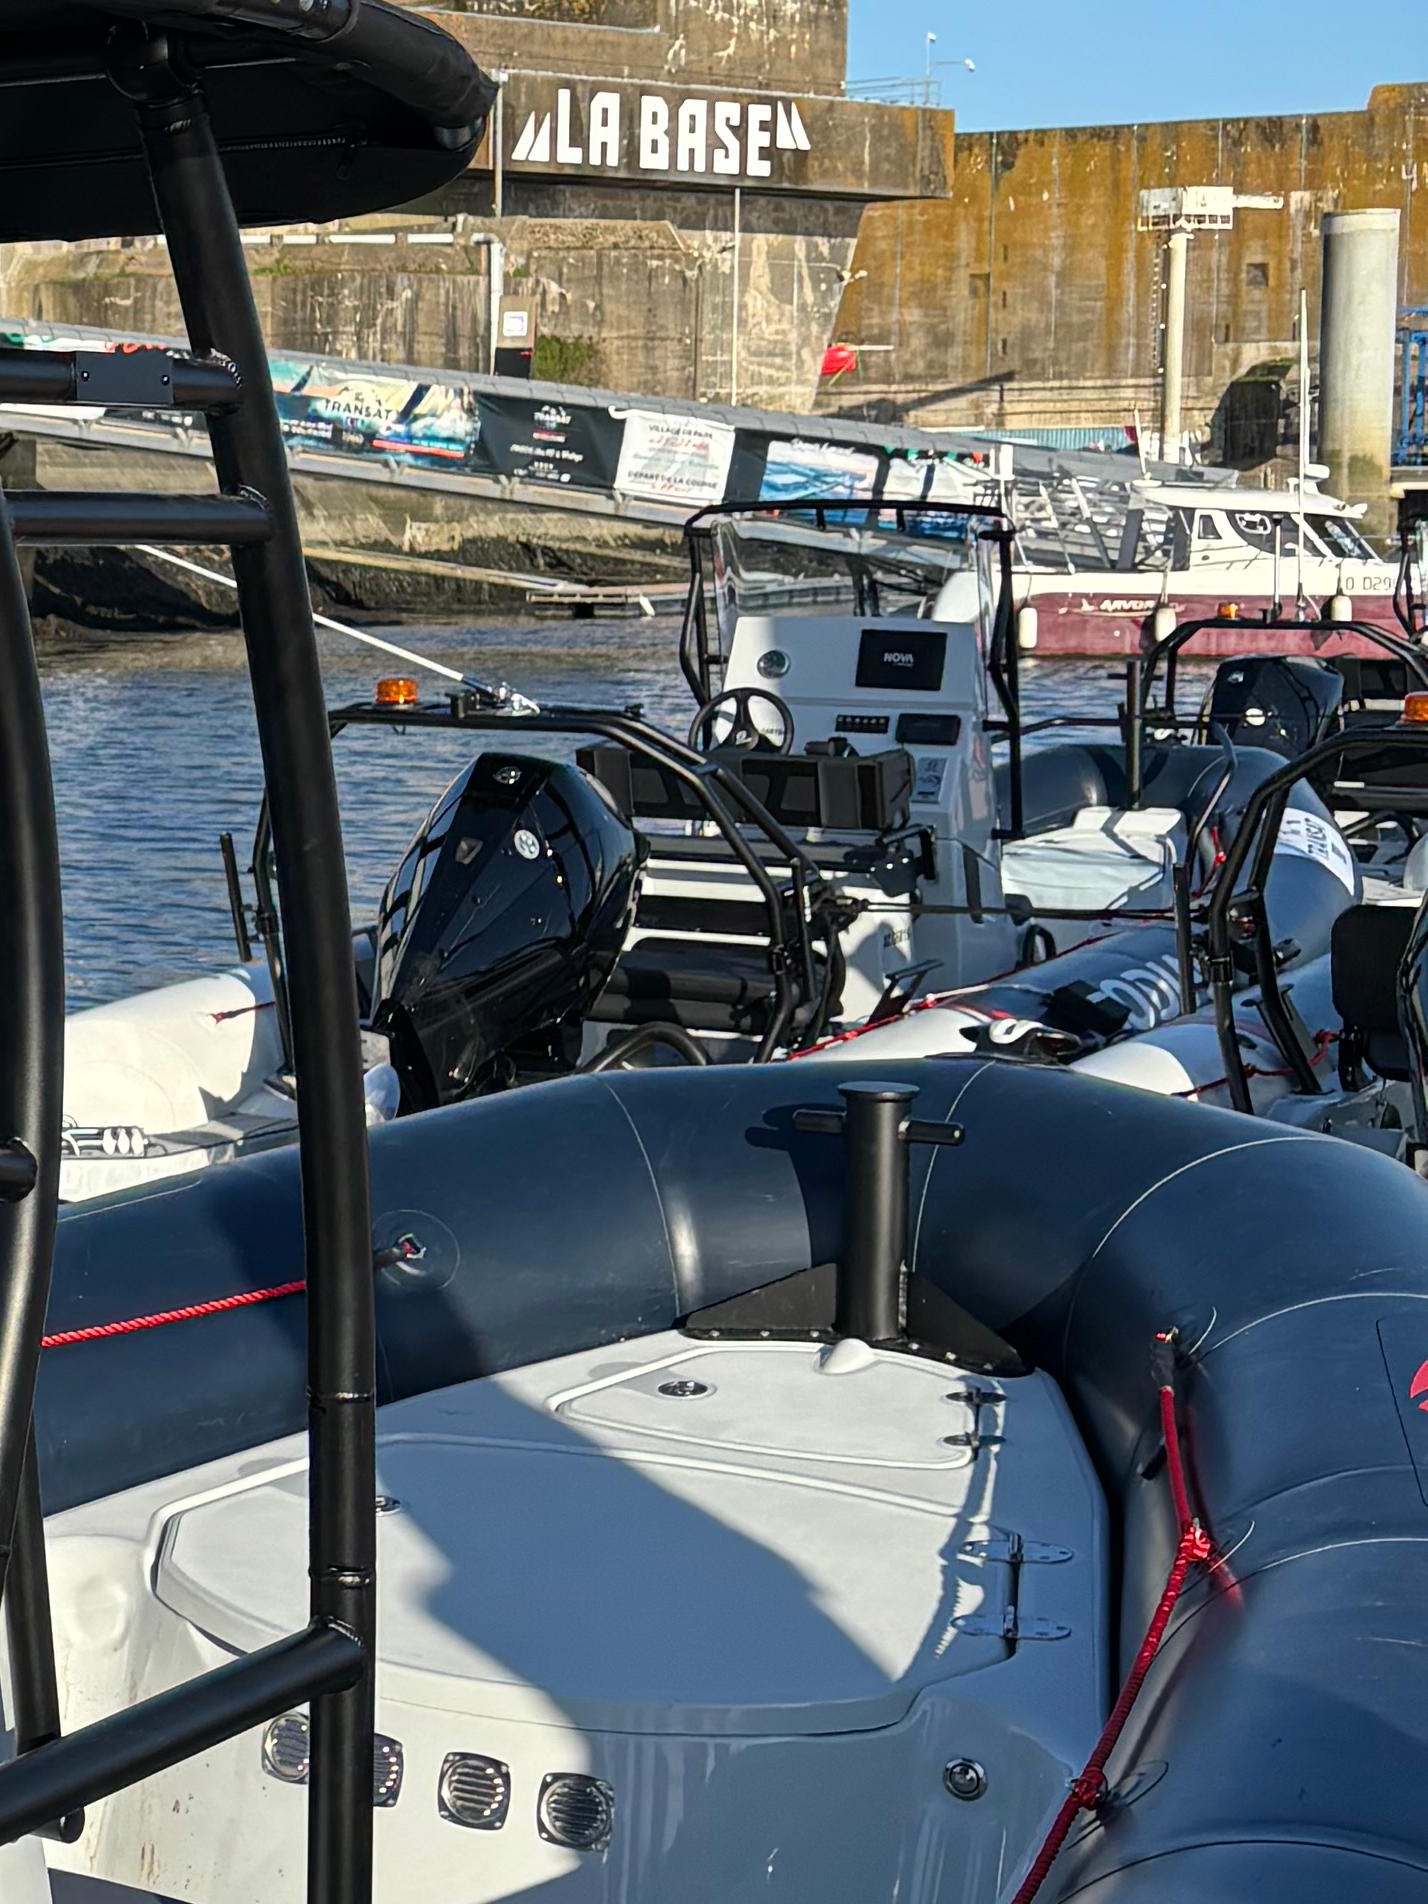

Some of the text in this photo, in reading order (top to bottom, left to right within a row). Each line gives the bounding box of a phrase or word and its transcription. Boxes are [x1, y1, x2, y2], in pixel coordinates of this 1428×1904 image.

[557, 88, 772, 177] LA BASE
[325, 399, 393, 421] TRANSAT
[1362, 576, 1397, 591] D29
